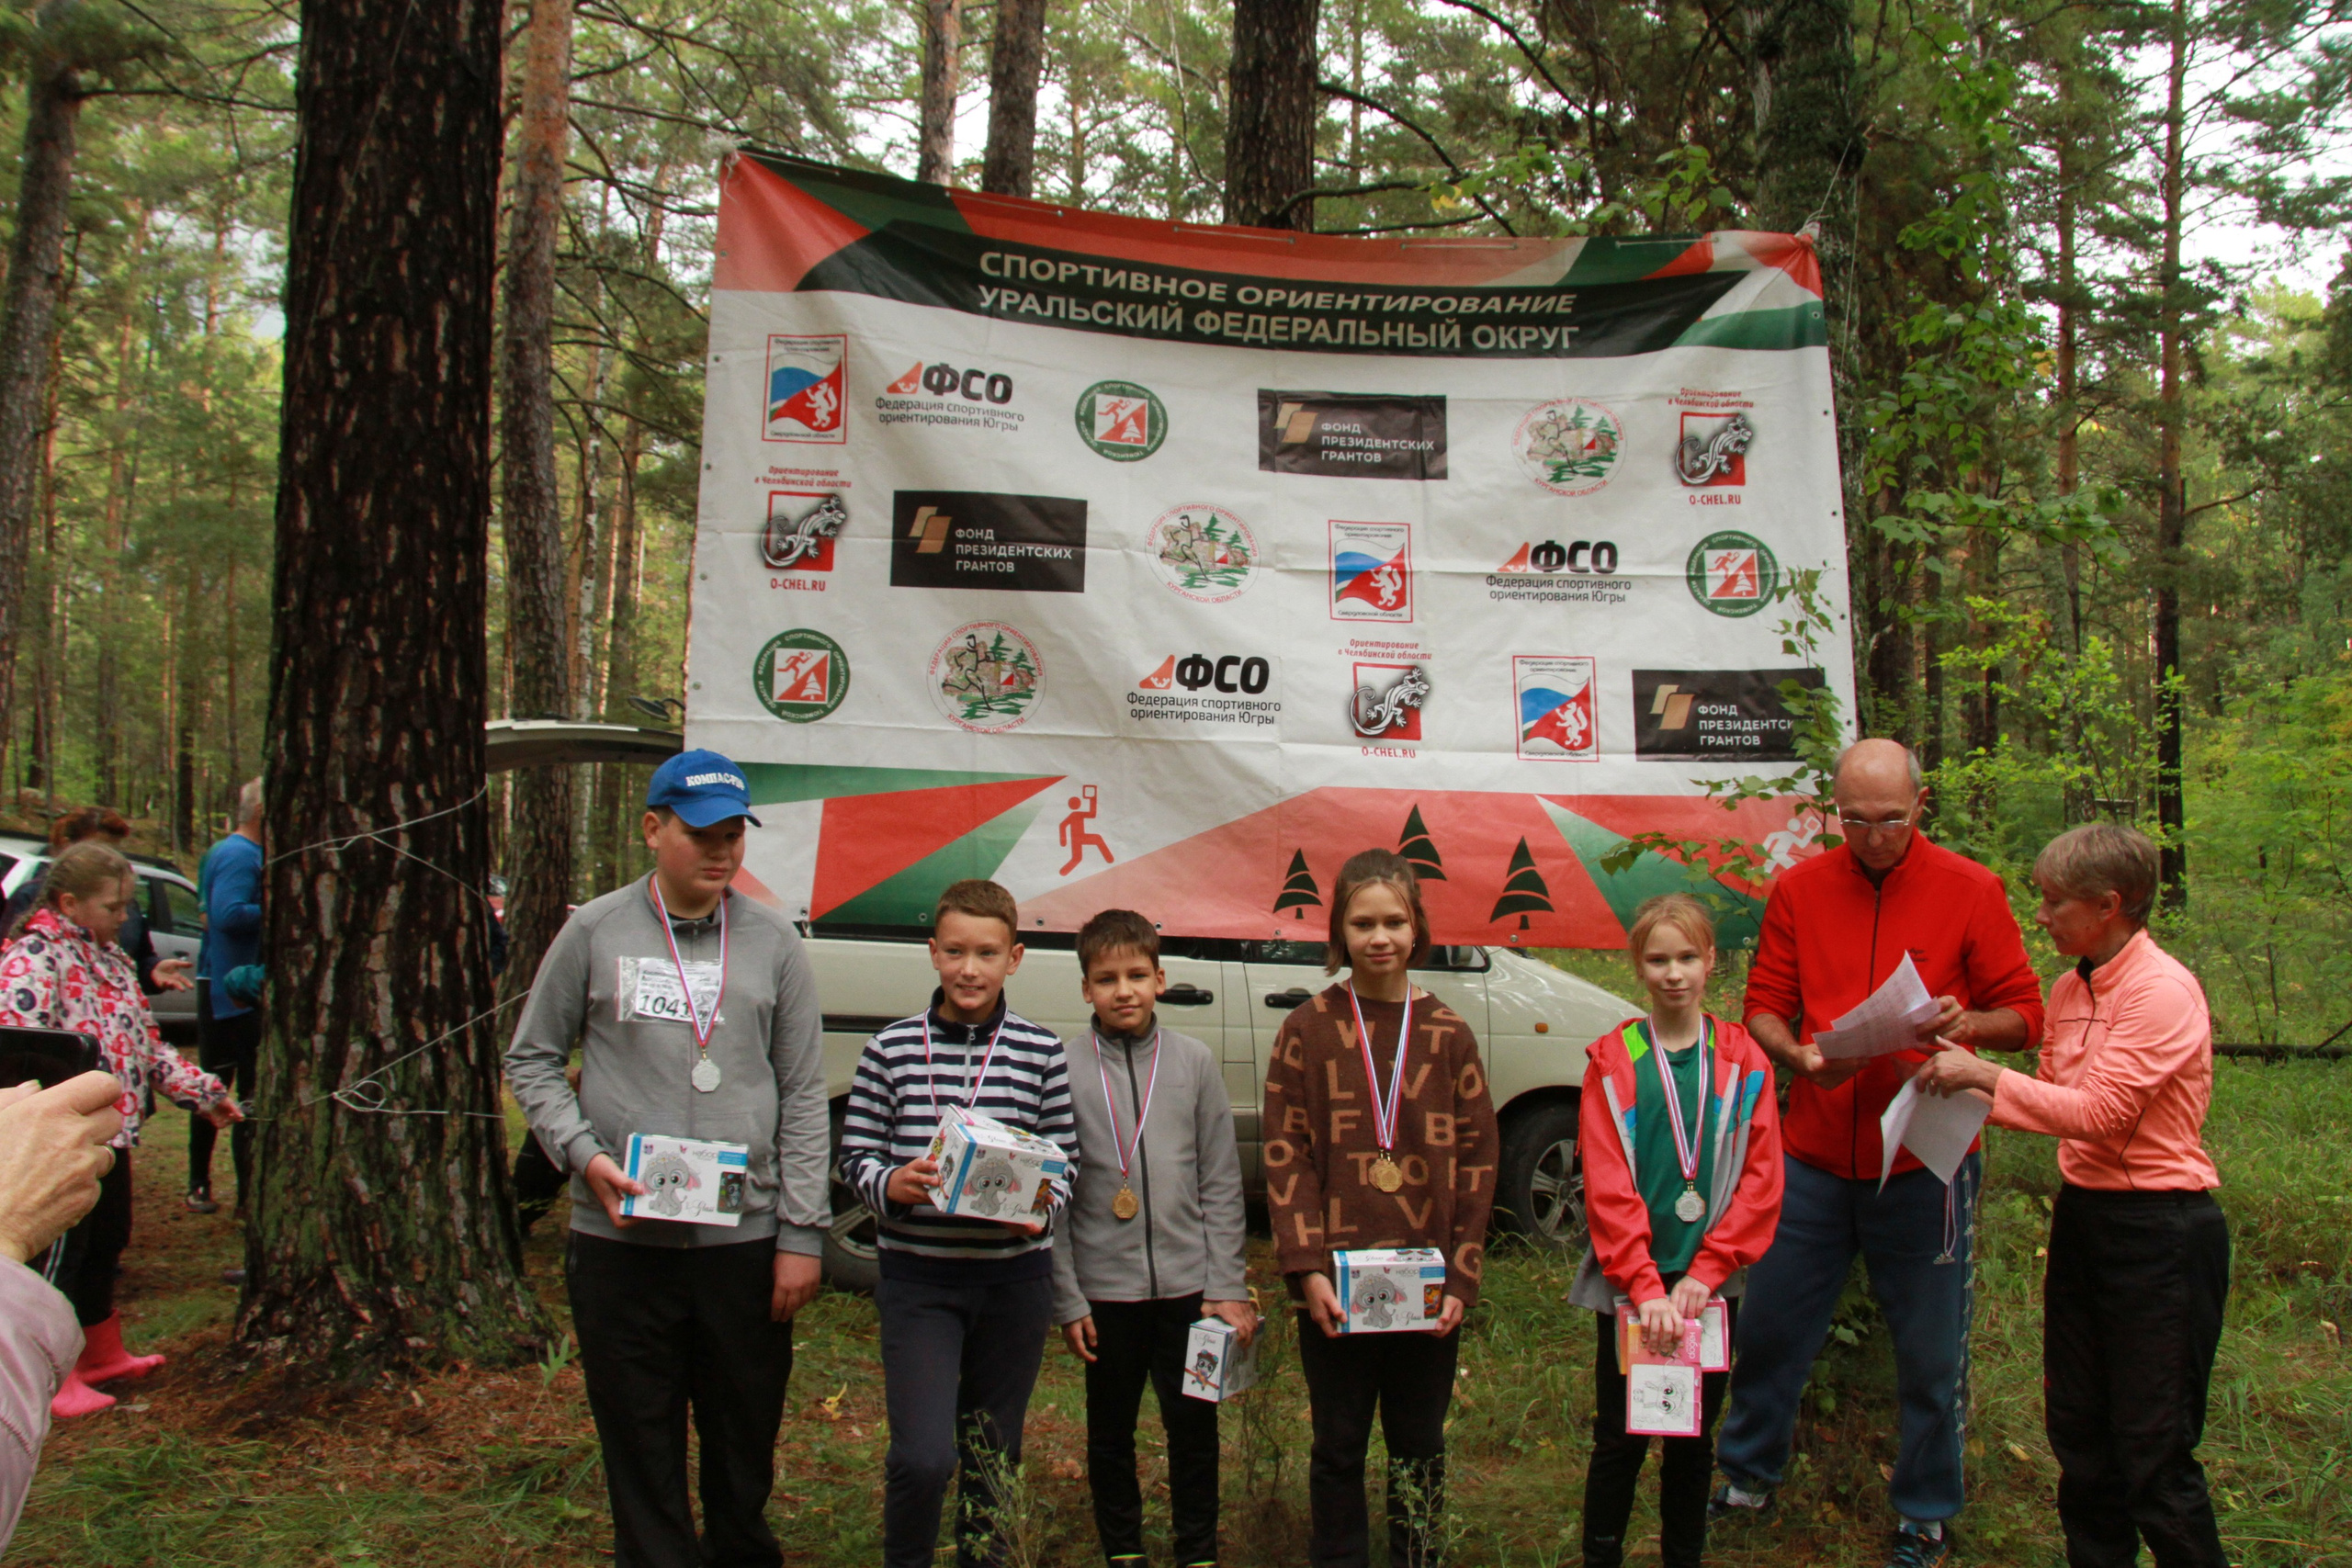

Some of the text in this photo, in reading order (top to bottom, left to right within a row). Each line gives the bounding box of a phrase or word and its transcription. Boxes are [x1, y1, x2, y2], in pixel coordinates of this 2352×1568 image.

[979, 251, 1577, 314] СПОРТИВНОЕ ОРИЕНТИРОВАНИЕ
[978, 284, 1580, 350] УРАЛЬСКИЙ ФЕДЕРАЛЬНЫЙ ОКРУГ
[922, 361, 1013, 404] ФСО
[876, 397, 1024, 422] Федерация спортивного
[878, 413, 1018, 432] ориентирования Югры
[1321, 423, 1362, 434] ФОНД
[1321, 435, 1434, 451] ПРЕЗИДЕНТСКИХ
[1321, 450, 1382, 463] ГРАНТОВ
[1689, 494, 1741, 505] O-CHEL.RU
[955, 528, 994, 541] ФОНД
[956, 544, 1072, 559] ПРЕЗИДЕНТСКИХ
[1530, 540, 1619, 574] ФСО
[956, 560, 1015, 572] ГРАНТОВ
[770, 578, 826, 592] O-CHEL.RU
[1486, 574, 1632, 592] Федерация спортивного
[1489, 590, 1625, 604] ориентирования Югры
[1175, 653, 1270, 694] ФСО
[1126, 692, 1281, 712] Федерация спортивного
[1698, 704, 1738, 716] ФОНД
[947, 713, 1025, 734] КУРГАНСКОЙ ОБЛАСТИ
[1130, 707, 1274, 727] ориентирования Югры
[1700, 735, 1761, 746] ГРАНТОВ
[1362, 746, 1416, 759] O-CHEL.RU
